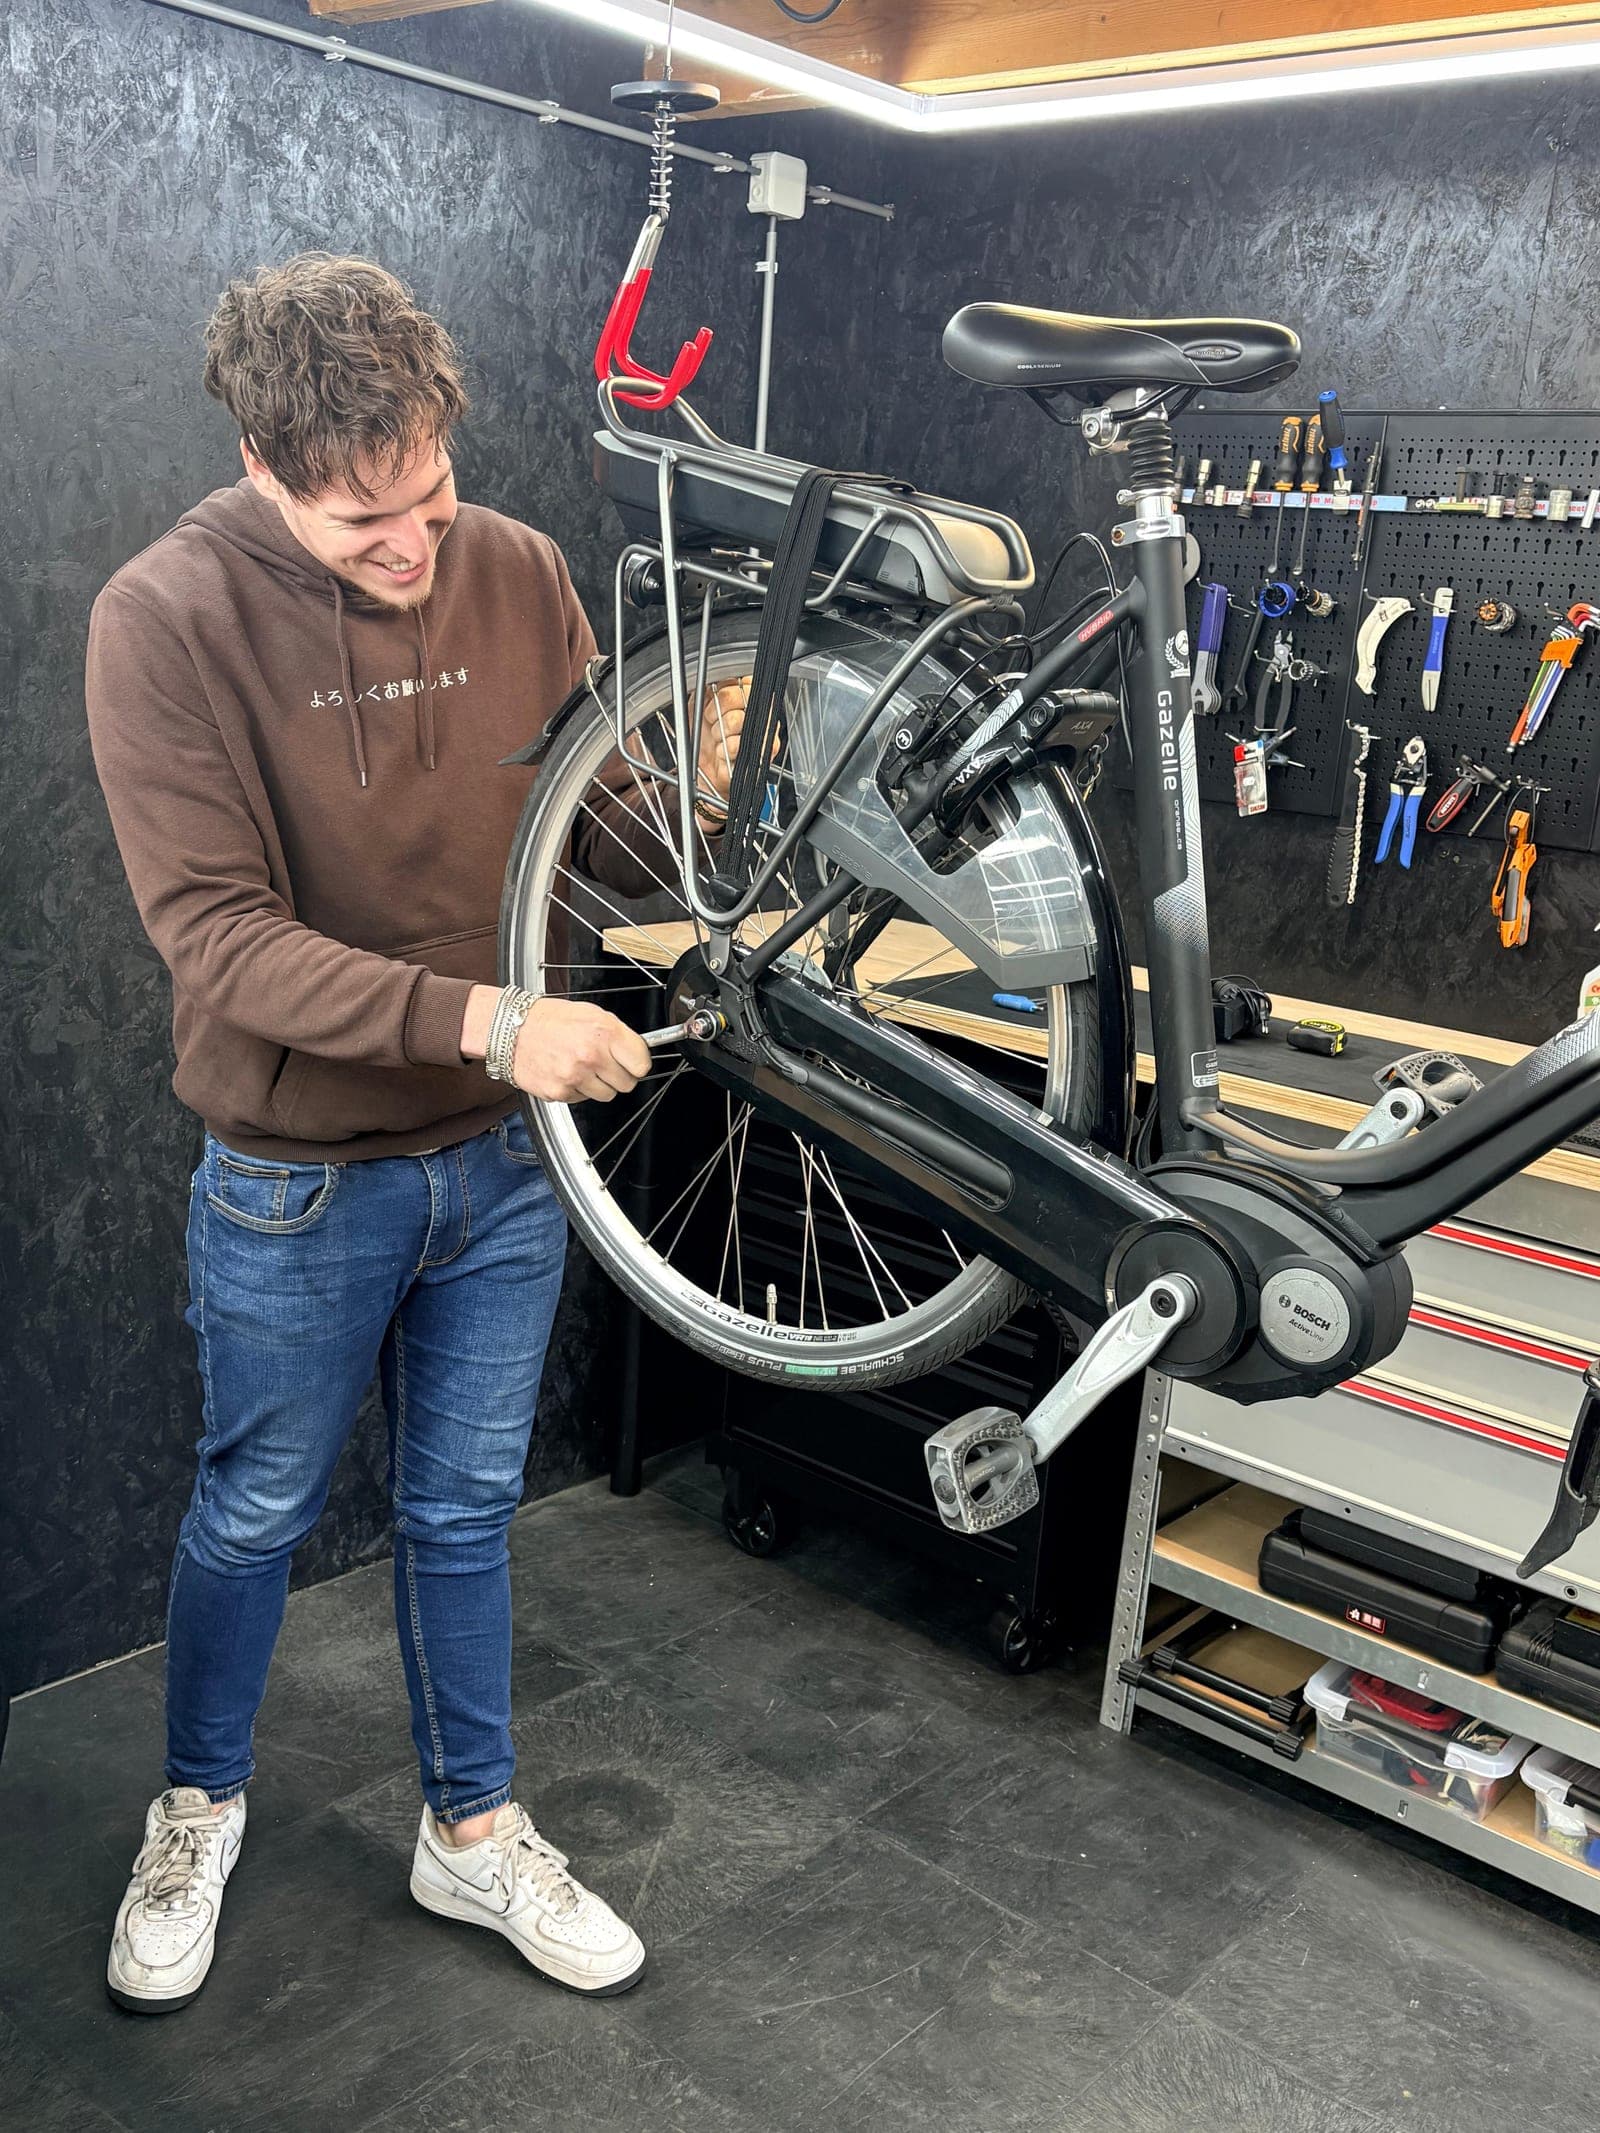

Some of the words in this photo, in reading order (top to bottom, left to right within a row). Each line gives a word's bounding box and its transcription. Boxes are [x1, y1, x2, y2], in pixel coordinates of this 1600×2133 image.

[1157, 690, 1179, 791] Gazelle
[955, 758, 981, 785] AXA
[703, 1304, 787, 1340] Gazelle
[1293, 1304, 1331, 1331] BOSCH
[747, 1355, 782, 1371] PLUS
[840, 1351, 905, 1376] SCHWALBE
